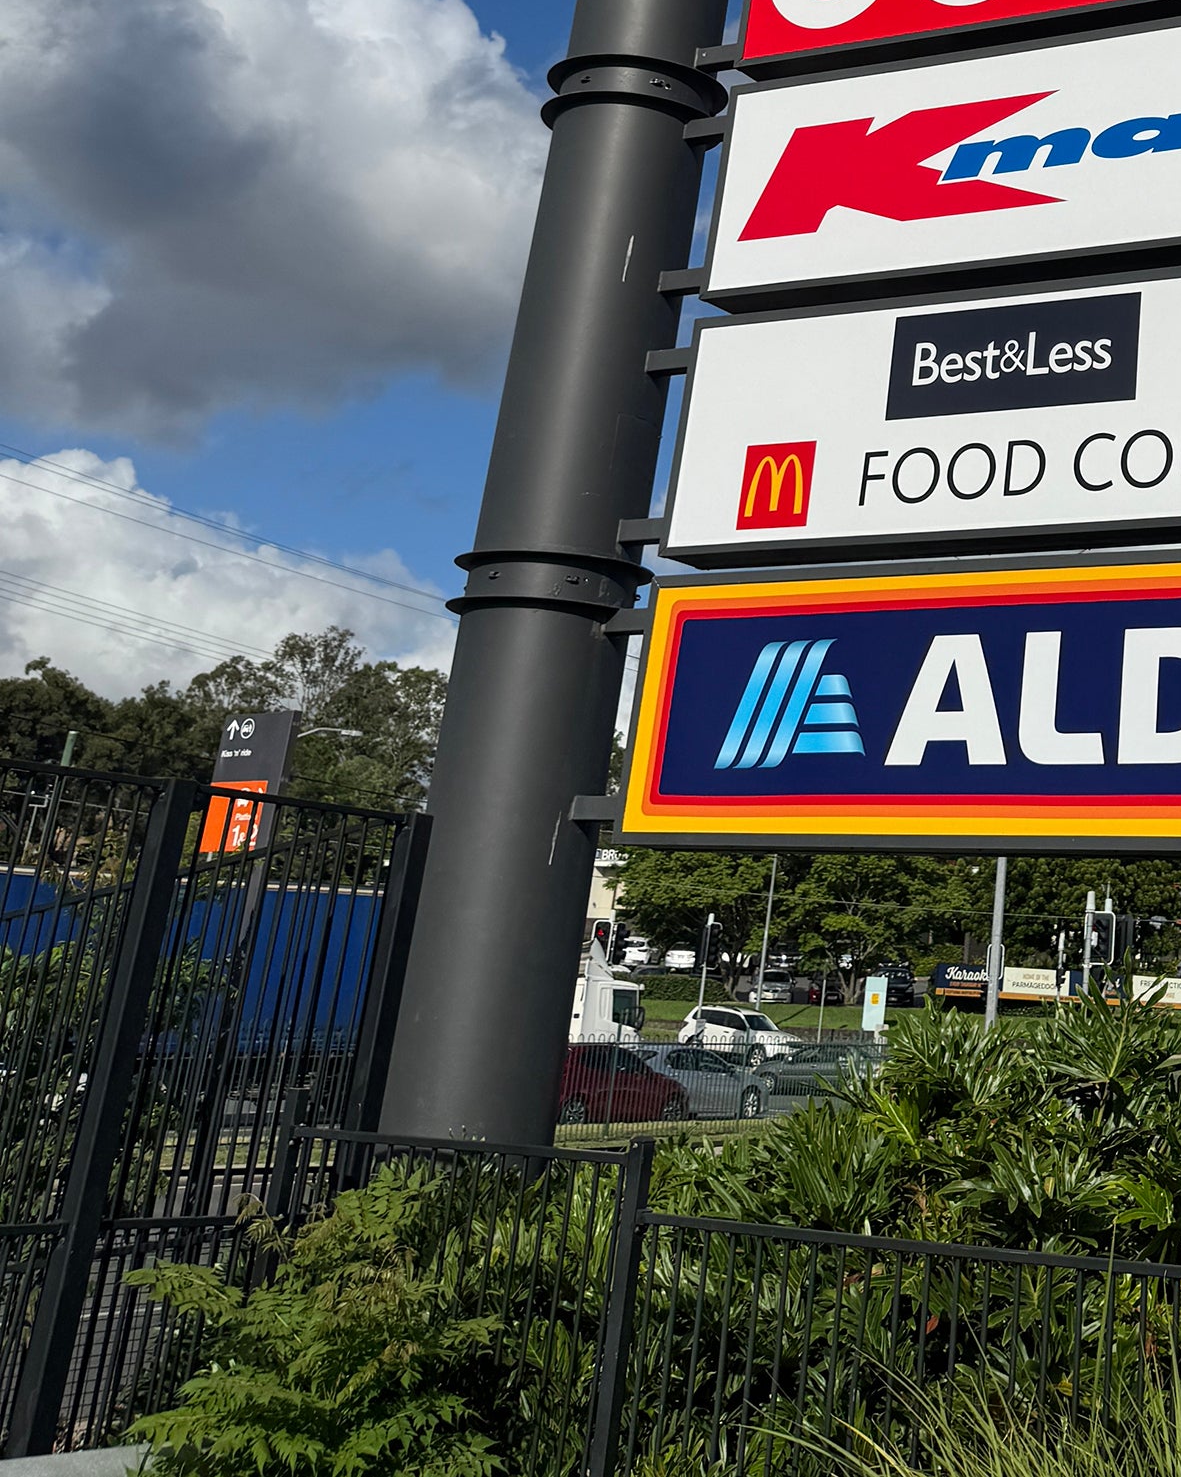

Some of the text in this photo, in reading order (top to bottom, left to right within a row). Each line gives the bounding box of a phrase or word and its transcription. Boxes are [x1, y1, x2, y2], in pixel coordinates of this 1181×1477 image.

[911, 330, 1112, 387] Best&Less
[858, 439, 1046, 507] FOOD
[944, 965, 989, 982] Karaok
